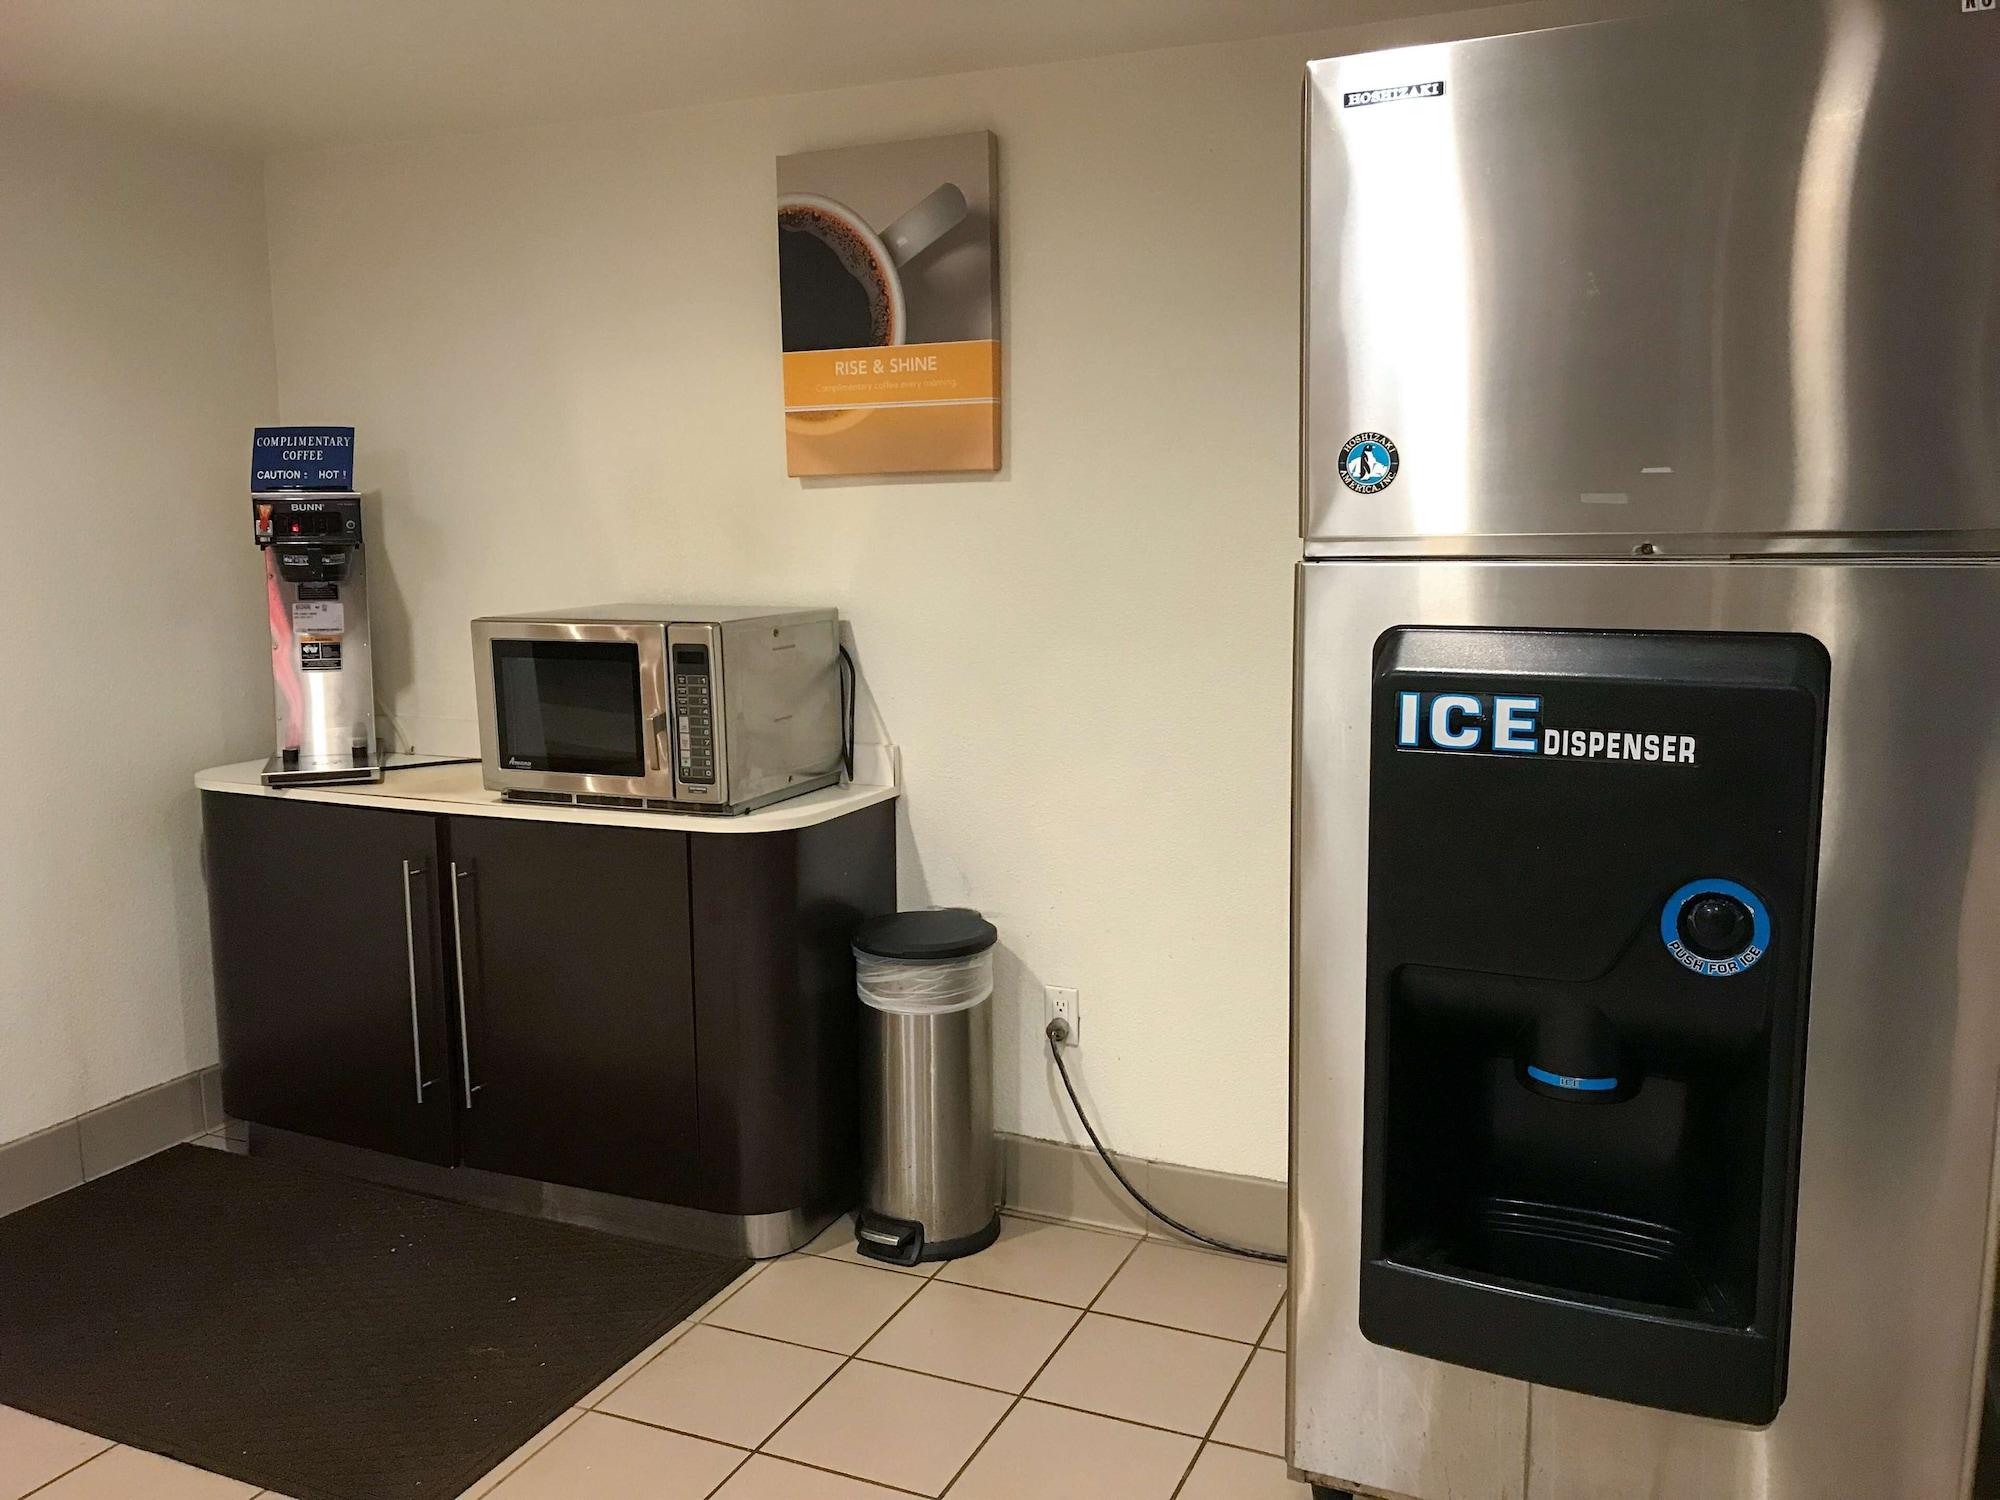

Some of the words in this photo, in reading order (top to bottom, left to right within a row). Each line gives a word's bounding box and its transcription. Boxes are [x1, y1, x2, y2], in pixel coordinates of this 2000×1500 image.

[1347, 82, 1440, 107] HOSHIZAKI
[835, 360, 868, 376] RISE
[873, 359, 885, 374] &
[889, 356, 938, 373] SHINE
[256, 436, 352, 447] COMPLIMENTARY
[1344, 433, 1396, 453] HOSHIZAKI
[282, 450, 324, 461] COFFEE
[290, 503, 323, 512] BUNN
[1398, 691, 1542, 753] ICE
[1544, 728, 1696, 764] DISPENSER
[1667, 940, 1705, 972] PUSH
[1707, 962, 1739, 975] FOR
[1739, 945, 1762, 968] ICE
